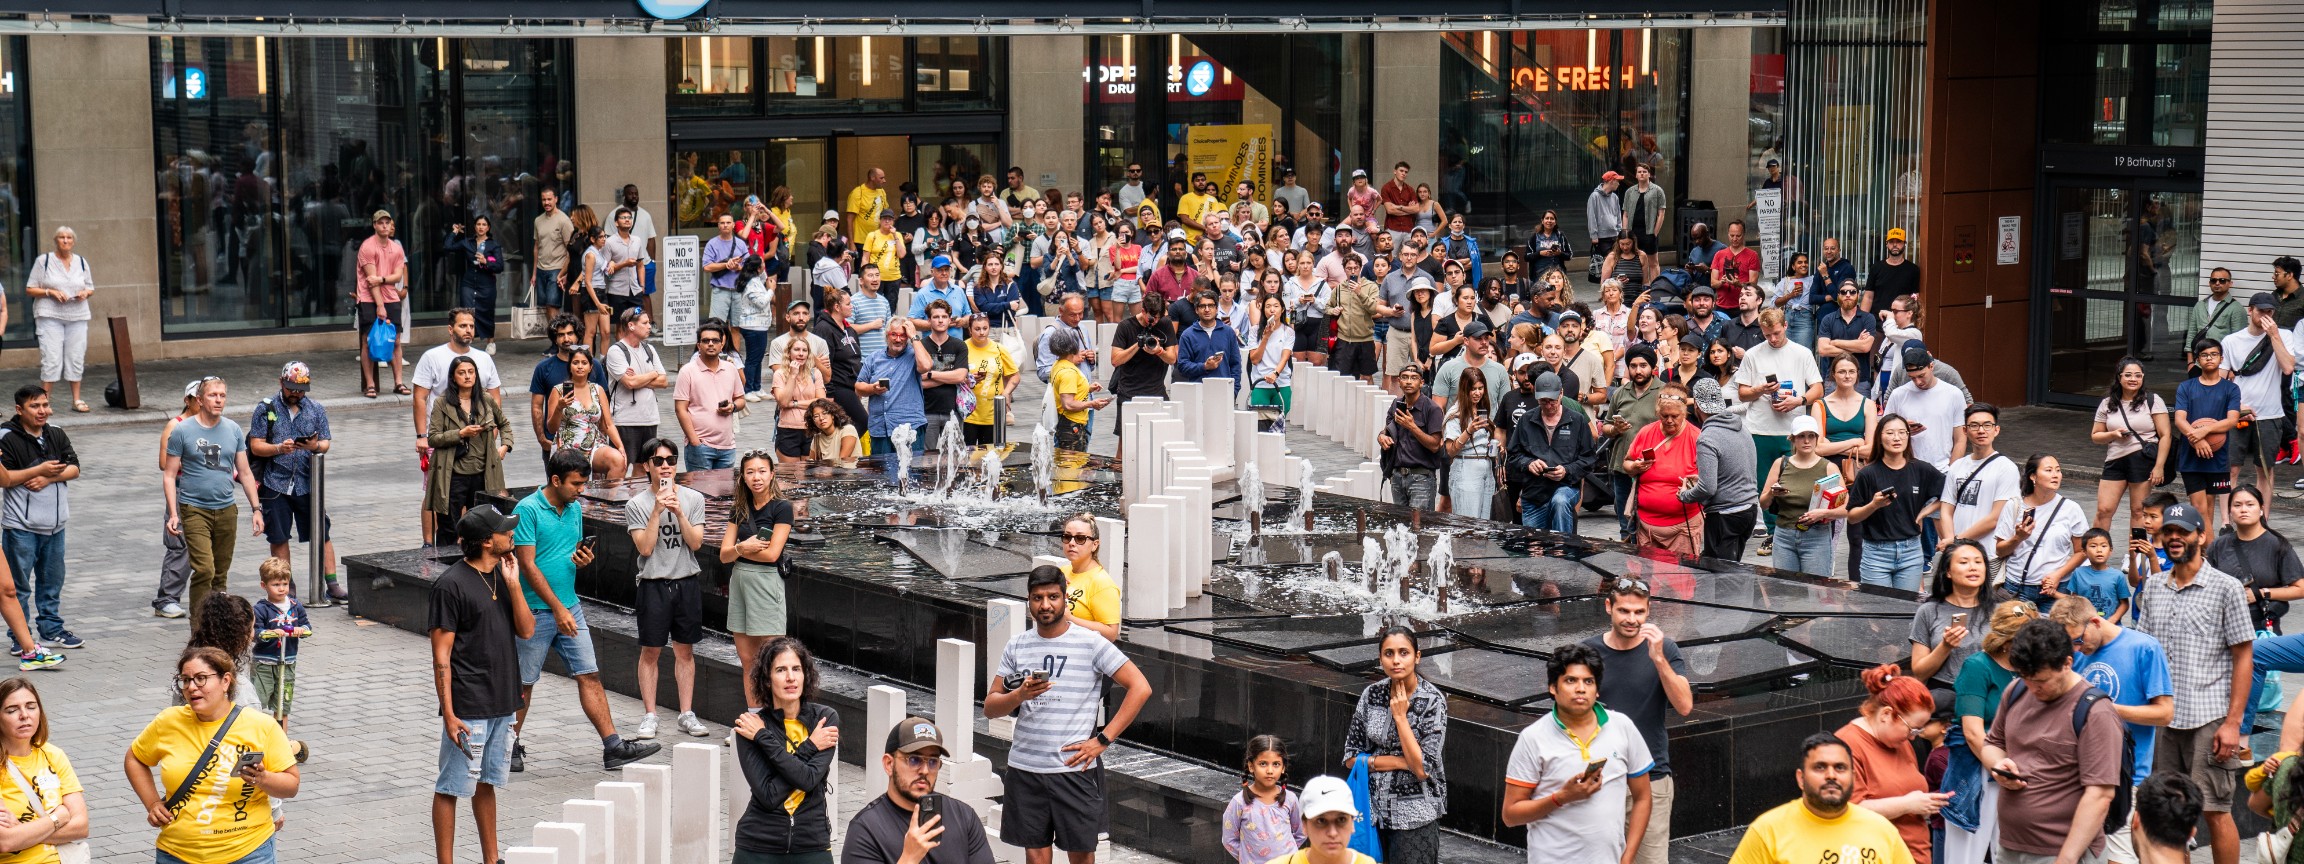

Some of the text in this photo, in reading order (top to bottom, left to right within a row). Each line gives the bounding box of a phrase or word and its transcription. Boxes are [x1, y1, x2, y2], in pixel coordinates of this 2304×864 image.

[1557, 66, 1634, 91] FRESH
[1108, 84, 1136, 94] DRU
[1244, 138, 1258, 180] MINOES
[2114, 156, 2176, 168] 19 Bathurst St
[1220, 142, 1249, 202] DOMINOES
[1258, 136, 1266, 202] DOMINOES
[675, 248, 686, 257] NO
[668, 259, 694, 268] PARKING
[668, 512, 672, 522] I
[663, 538, 680, 549] YA
[171, 754, 219, 820] DOMINOES
[196, 745, 236, 825] DOMINOES
